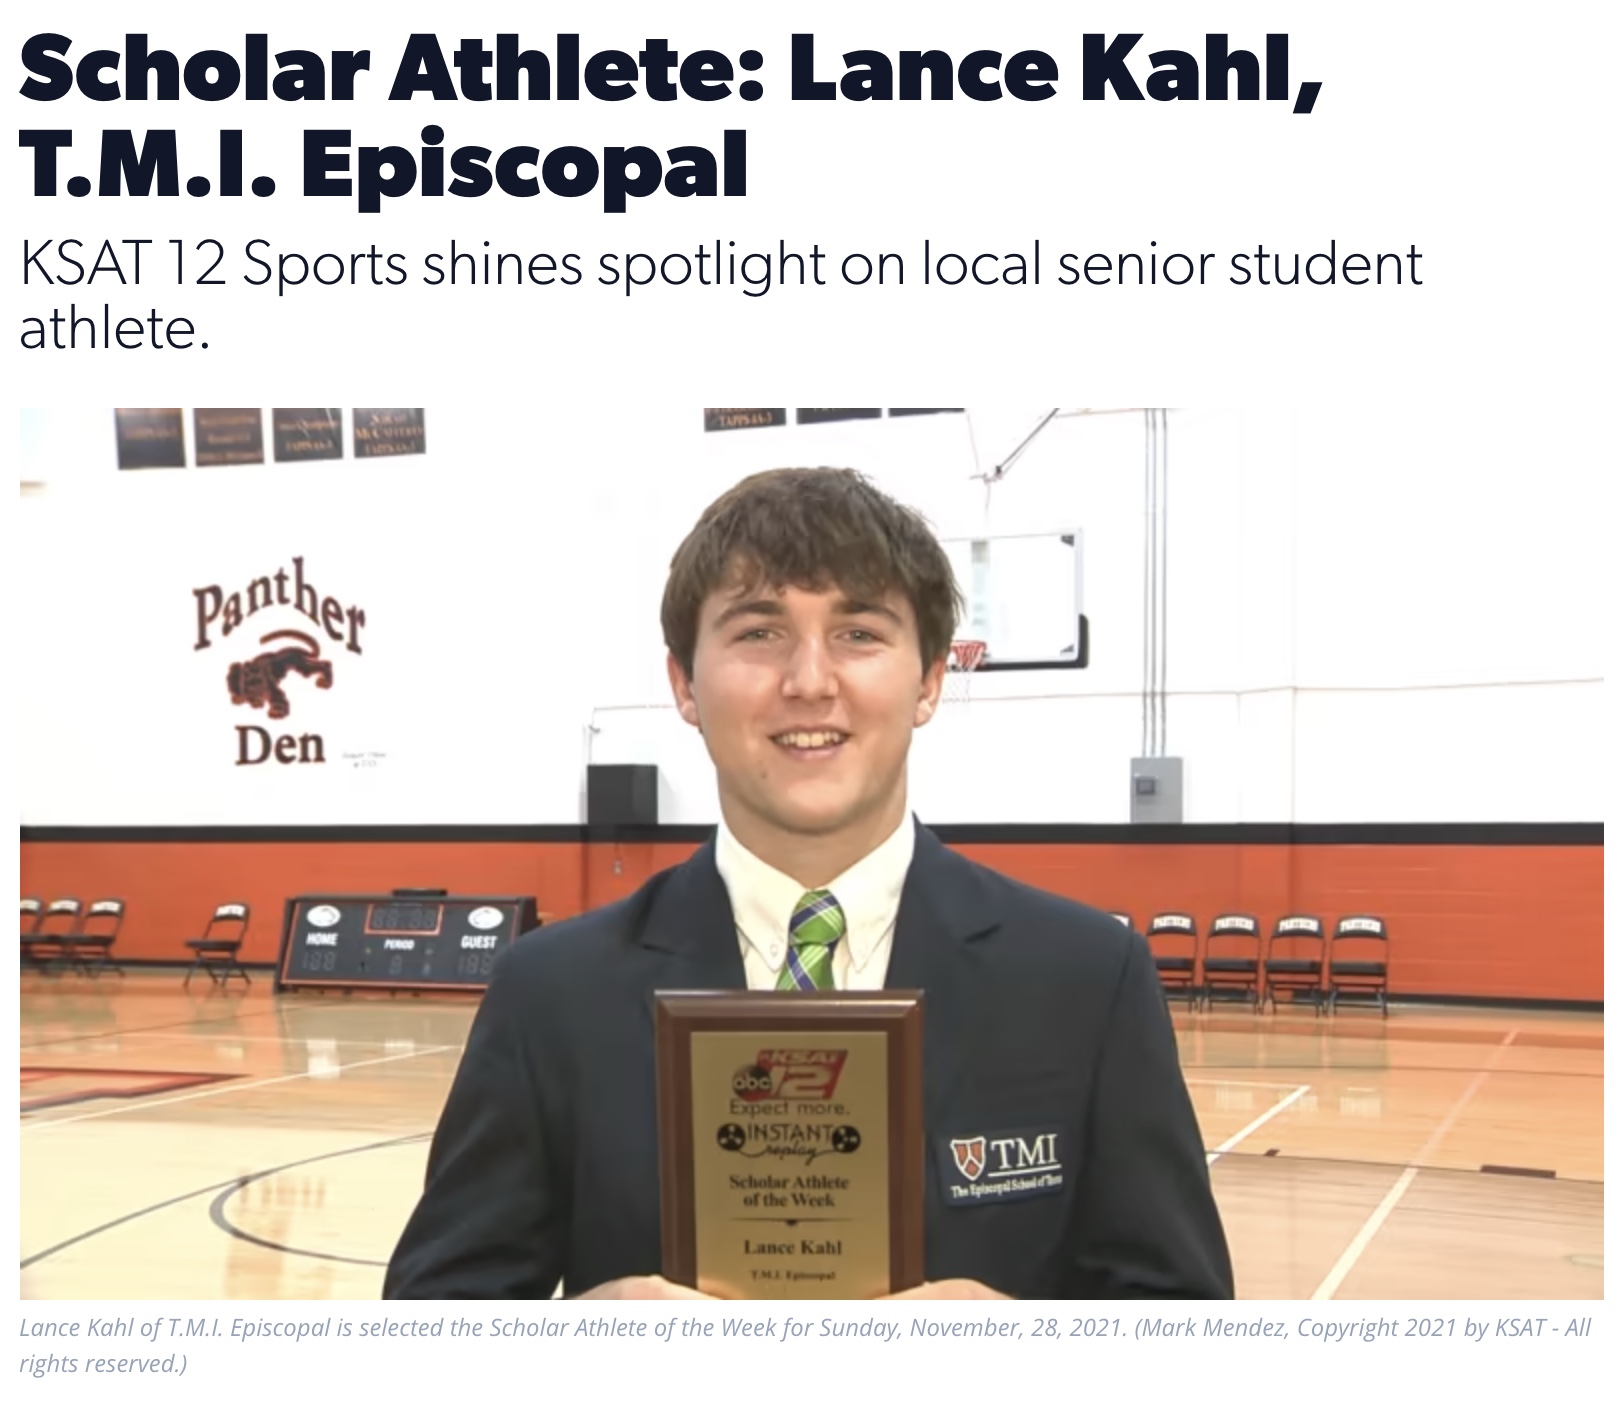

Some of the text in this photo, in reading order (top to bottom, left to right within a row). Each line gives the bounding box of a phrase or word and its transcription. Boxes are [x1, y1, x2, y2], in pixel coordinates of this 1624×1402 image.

[192, 555, 366, 656] Panther
[234, 725, 326, 766] Den
[305, 932, 338, 946] HOME
[384, 938, 415, 951] PERIOD
[461, 934, 498, 950] GUEST
[734, 1064, 833, 1099] abc 12
[729, 1099, 851, 1119] Expect more.
[748, 1123, 834, 1142] INSTANT
[990, 1133, 1058, 1169] TMI
[729, 1174, 849, 1191] Scholar Athlete
[743, 1192, 836, 1208] of the Week
[950, 1185, 969, 1199] The
[743, 1239, 842, 1256] Lance Kahl
